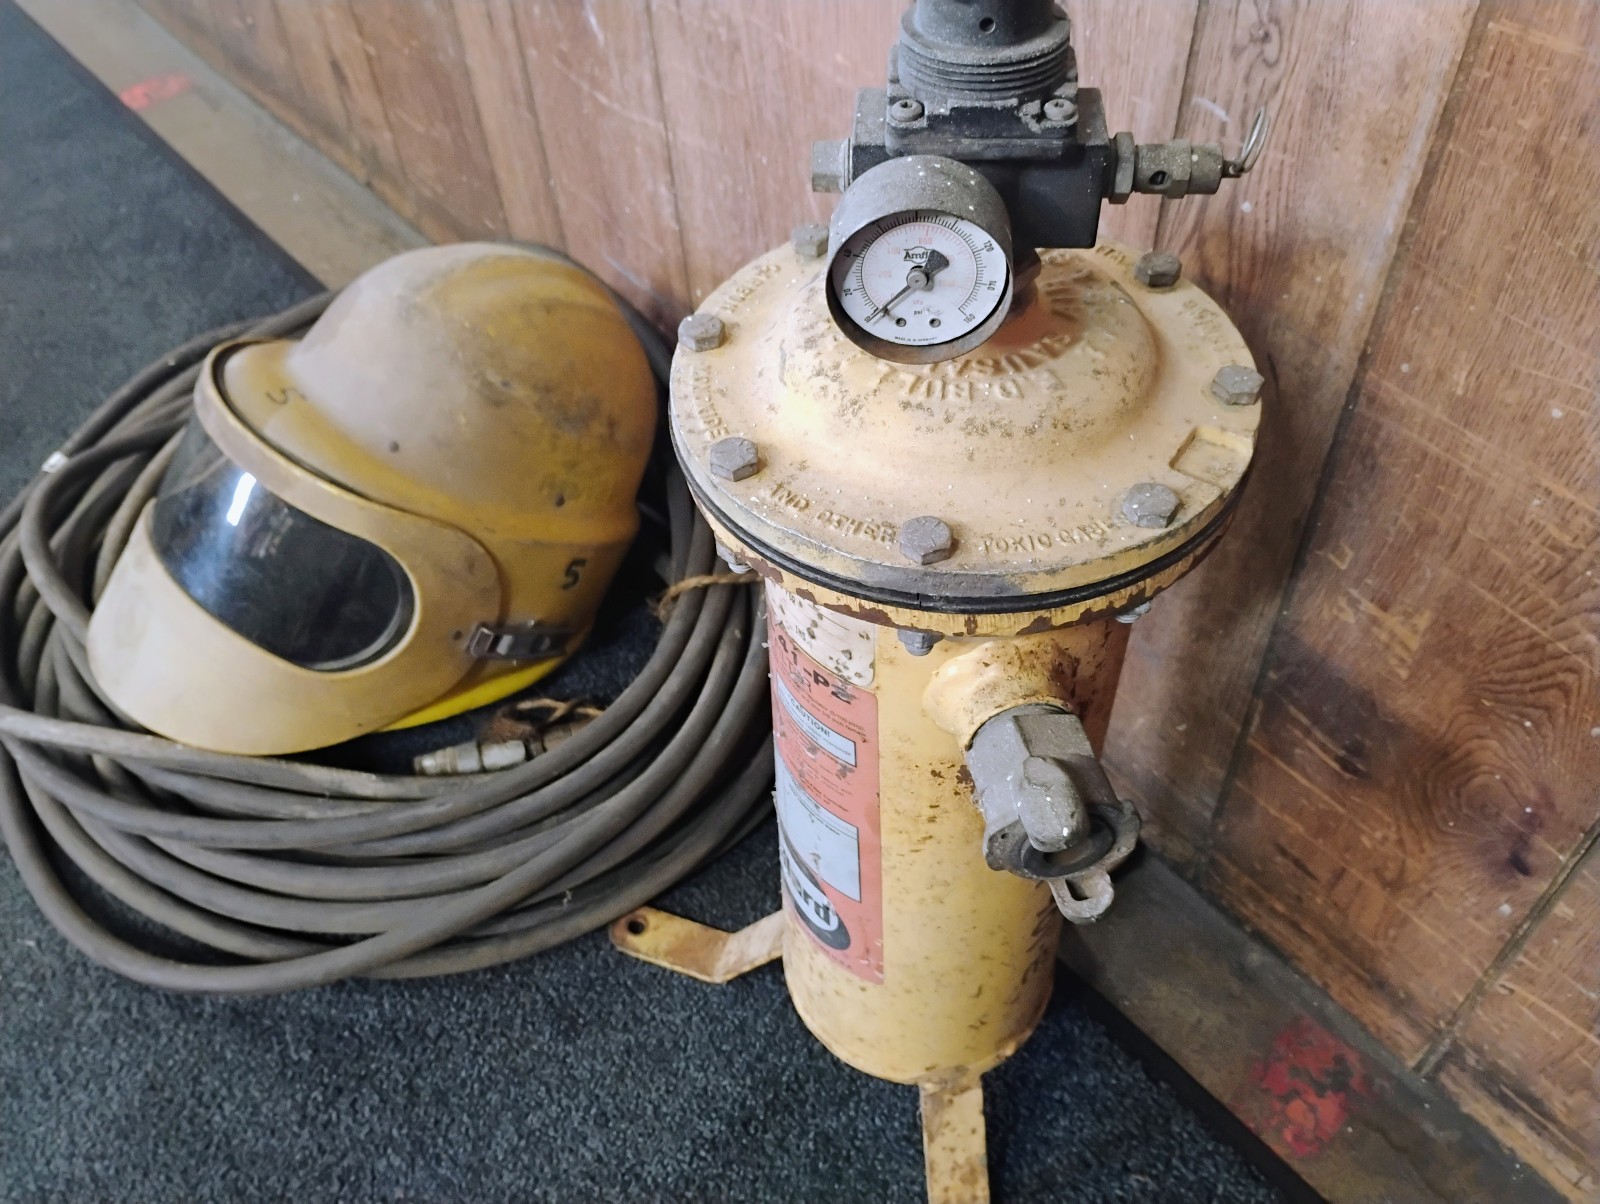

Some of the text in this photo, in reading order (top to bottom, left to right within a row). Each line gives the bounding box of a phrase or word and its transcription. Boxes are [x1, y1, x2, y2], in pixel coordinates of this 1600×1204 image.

[983, 239, 994, 252] 120
[986, 280, 996, 291] 140
[843, 288, 852, 296] 20
[913, 308, 922, 317] psi
[863, 315, 871, 323] 0
[963, 313, 975, 324] 160
[560, 557, 587, 591] 5
